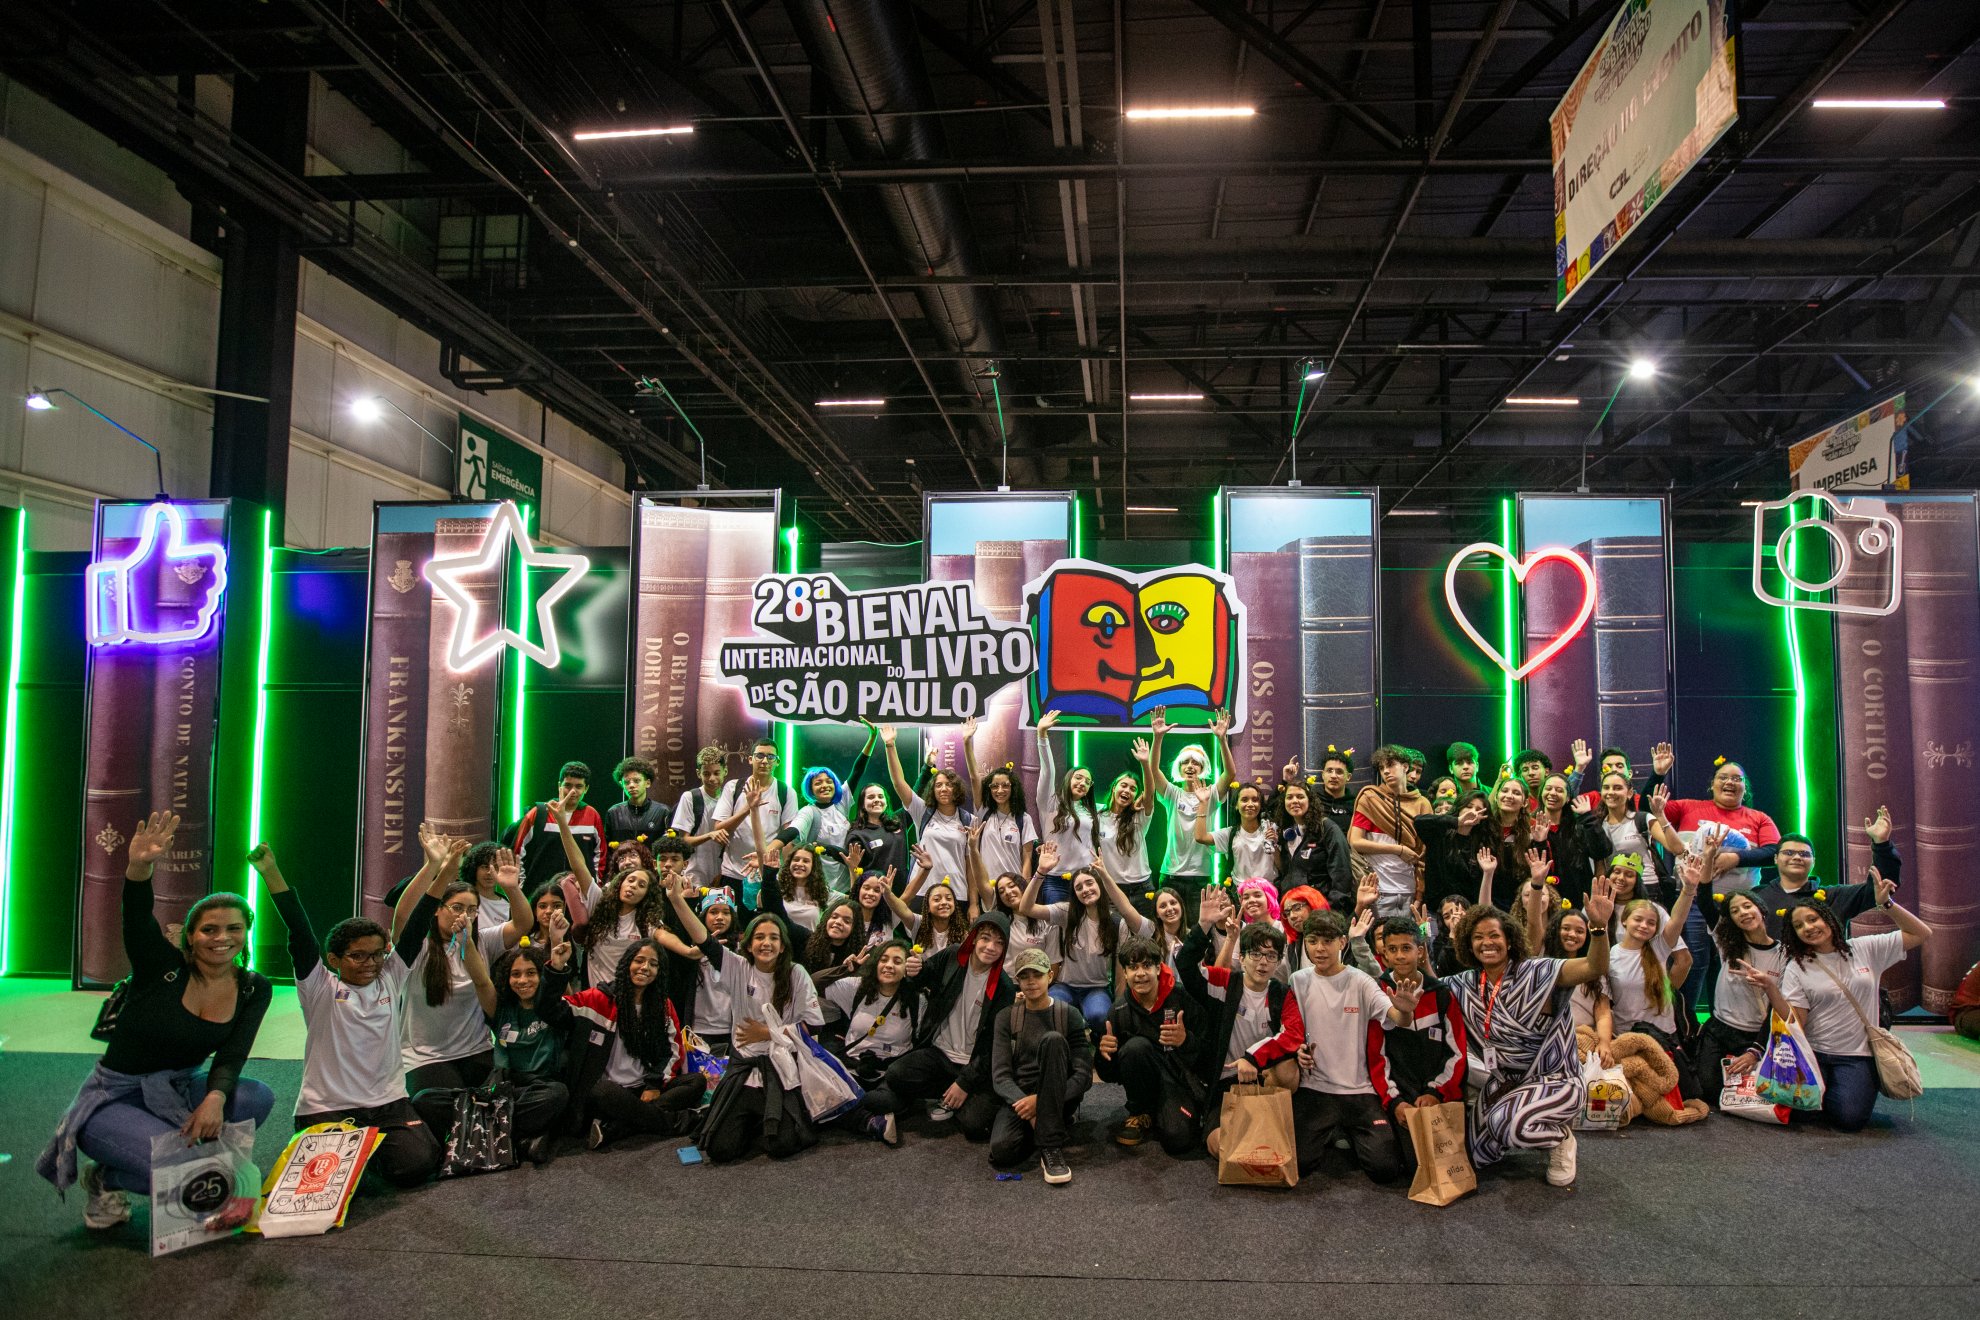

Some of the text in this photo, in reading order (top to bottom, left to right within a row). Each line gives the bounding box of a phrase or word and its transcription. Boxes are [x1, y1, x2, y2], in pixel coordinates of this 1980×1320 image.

[1568, 122, 1618, 203] DIREÇÃO
[491, 469, 535, 497] EMERGÊNCIA
[1814, 458, 1877, 489] IMPRENSA
[757, 579, 984, 644] 28ª BIENAL
[642, 637, 663, 716] DORIAN
[724, 631, 1031, 679] INTERNACIONAL DO LIVRO
[1252, 661, 1275, 697] OS
[178, 656, 196, 716] CONTO
[667, 632, 690, 787] O RETRATO DE
[751, 671, 977, 718] DE SÃO PAULO
[1862, 639, 1888, 780] O CORTIÇO
[175, 723, 192, 746] DE
[383, 656, 410, 855] FRANKENSTEIN
[172, 754, 189, 810] NATAL
[191, 1176, 222, 1202] 25
